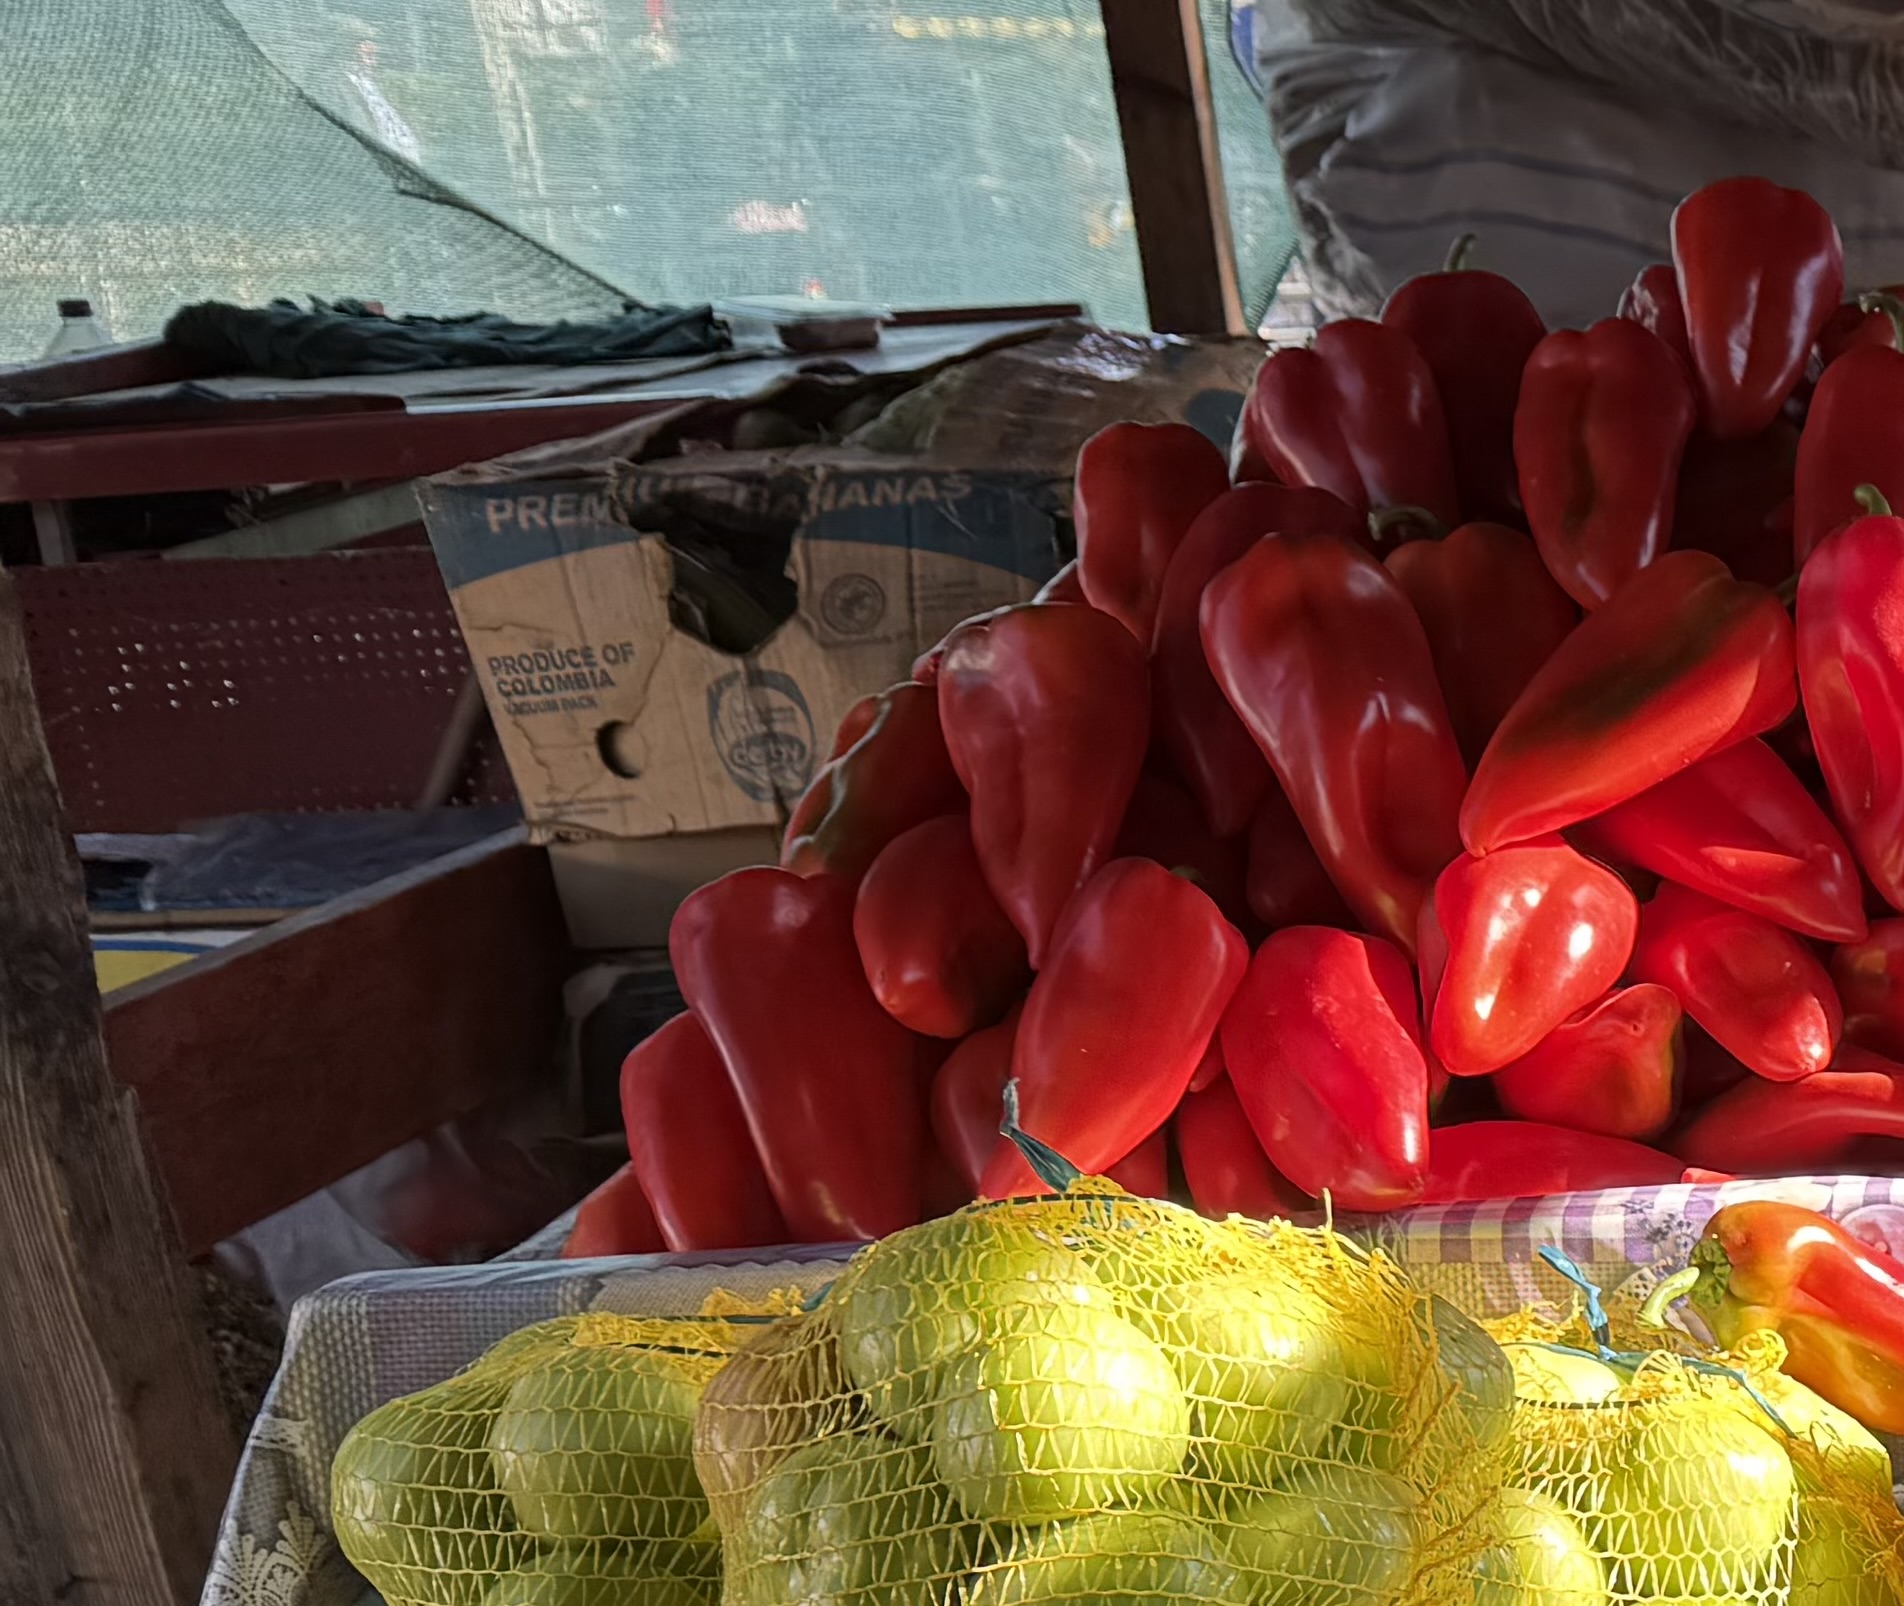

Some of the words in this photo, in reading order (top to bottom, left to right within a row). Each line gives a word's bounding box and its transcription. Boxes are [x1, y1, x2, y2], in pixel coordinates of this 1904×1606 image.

[487, 646, 597, 677] PRODUCE
[602, 641, 636, 665] OF
[496, 668, 616, 698] COLOMBIA
